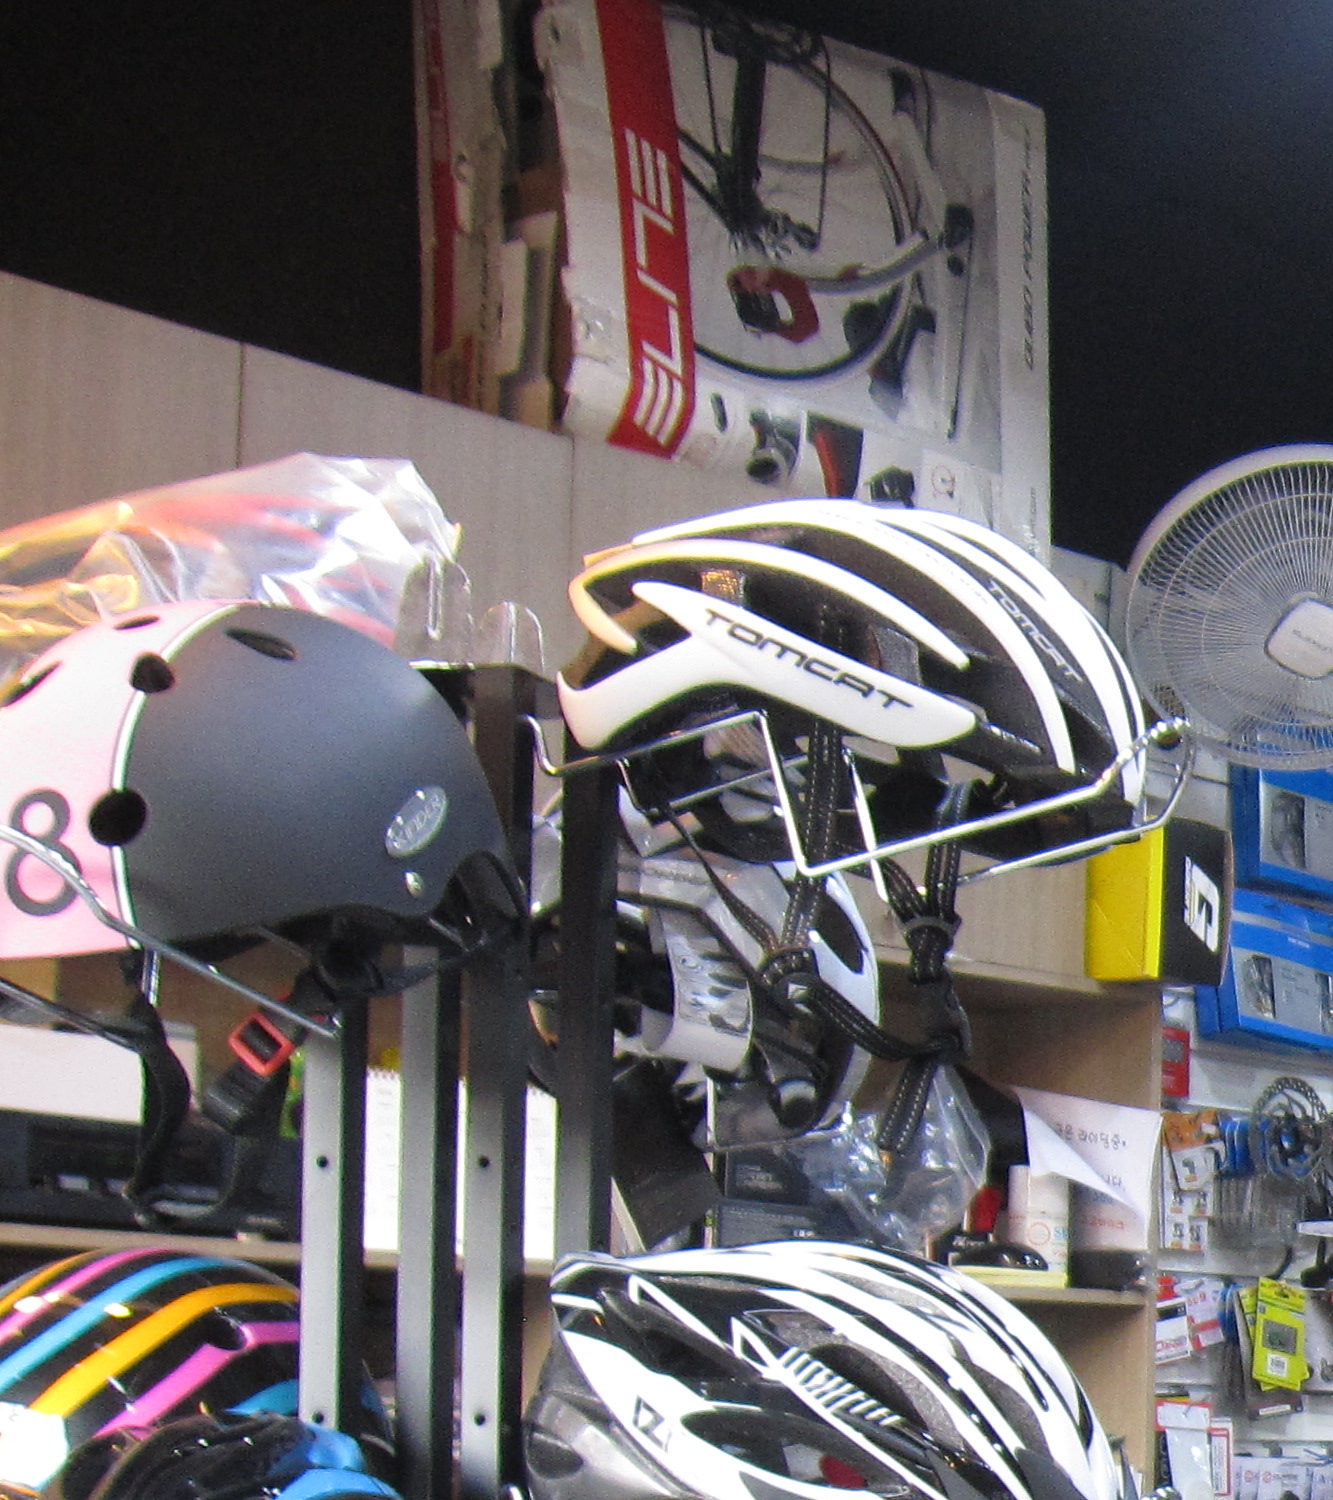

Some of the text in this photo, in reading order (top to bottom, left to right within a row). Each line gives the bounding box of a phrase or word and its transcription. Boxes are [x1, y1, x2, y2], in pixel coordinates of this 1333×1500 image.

[625, 128, 684, 444] ELITE
[703, 606, 914, 710] TOMCAT
[988, 577, 1083, 682] TOMCAT
